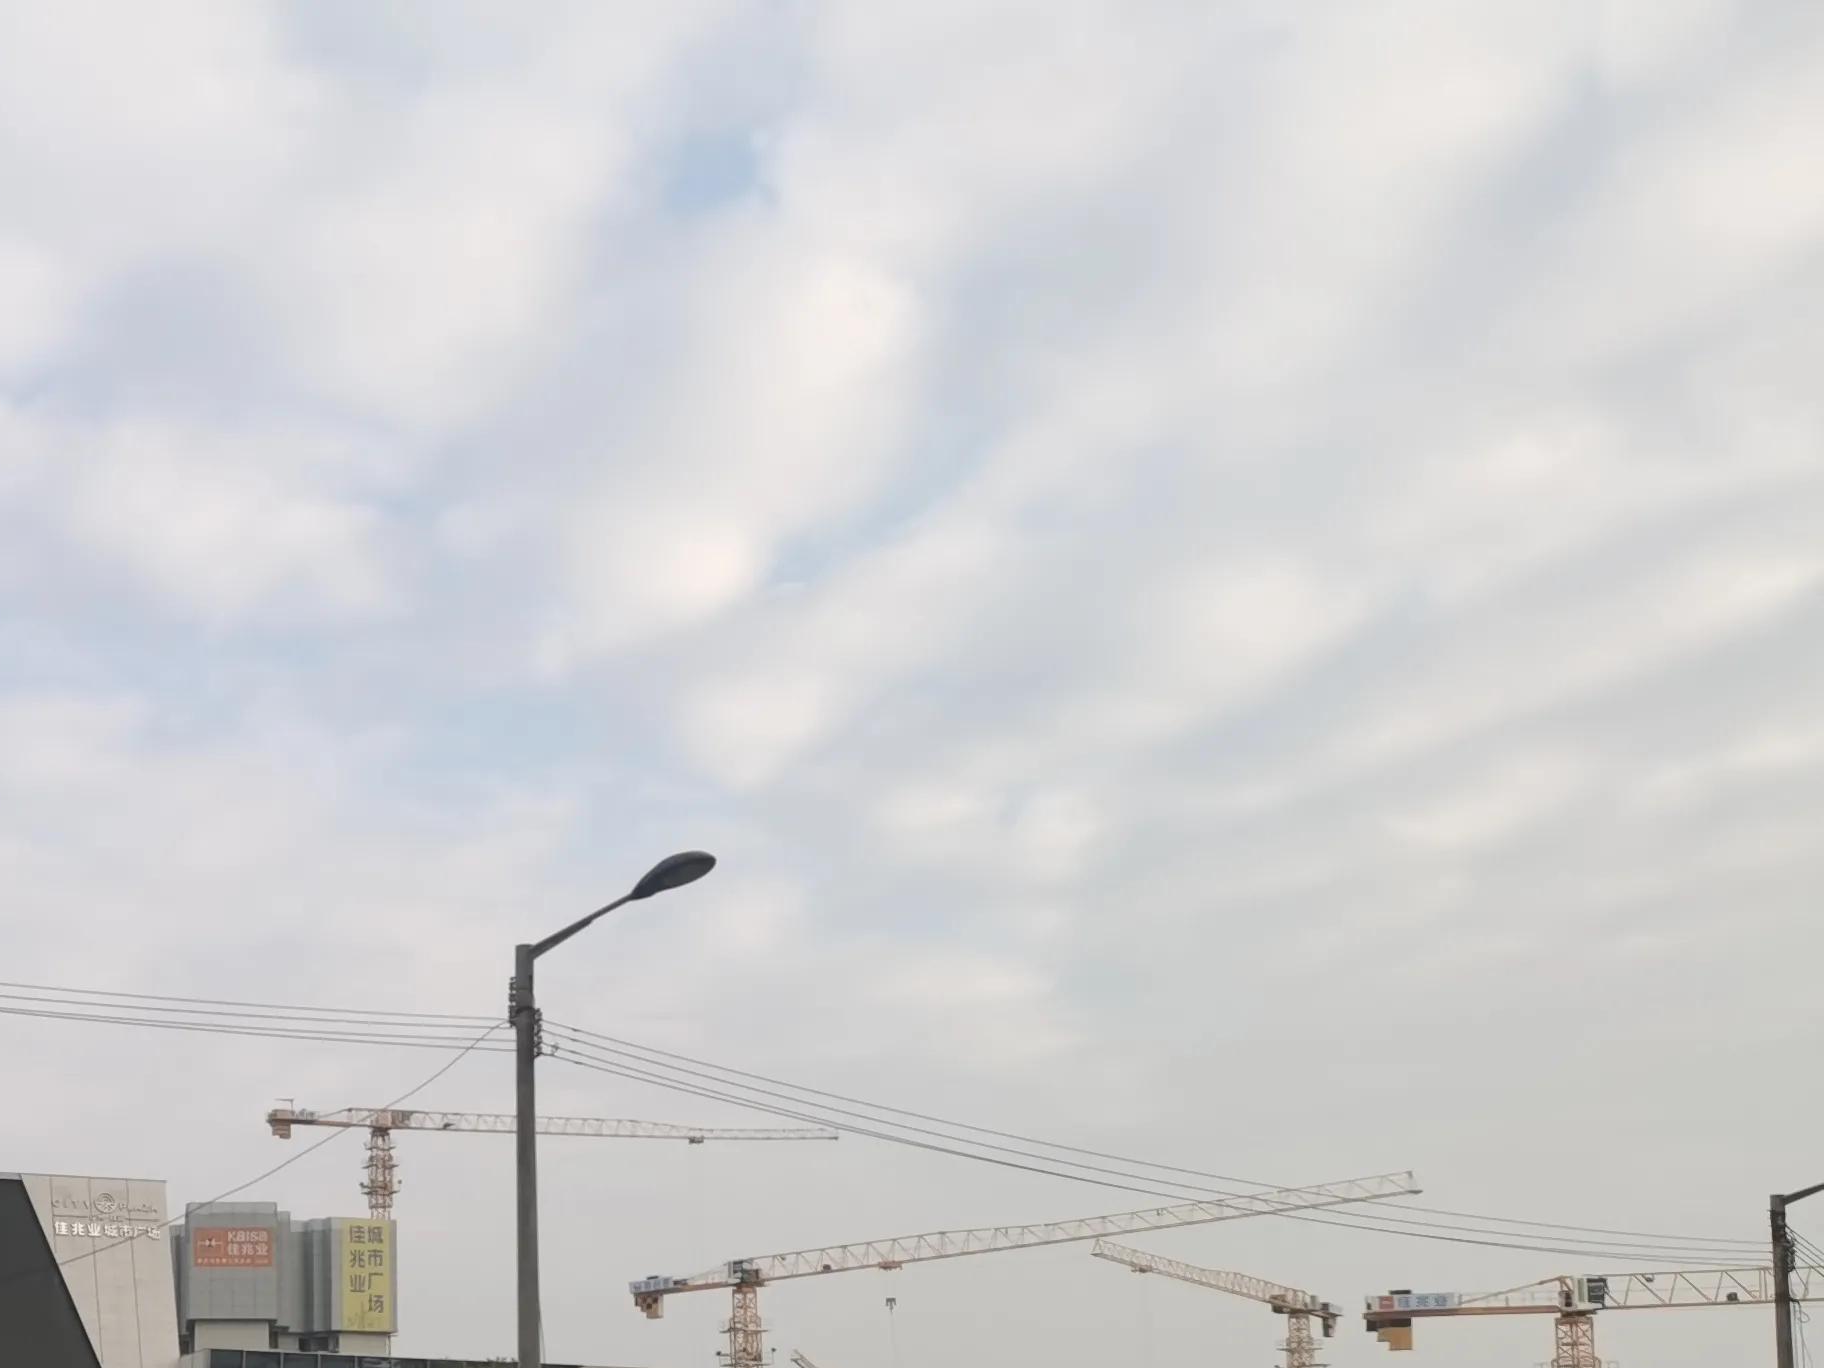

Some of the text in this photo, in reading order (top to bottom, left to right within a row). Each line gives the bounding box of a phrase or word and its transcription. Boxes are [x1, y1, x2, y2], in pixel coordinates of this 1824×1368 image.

[54, 1221, 161, 1240] 佳兆业城市广场
[349, 1225, 366, 1293] 佳兆业
[367, 1225, 384, 1313] 城市广场
